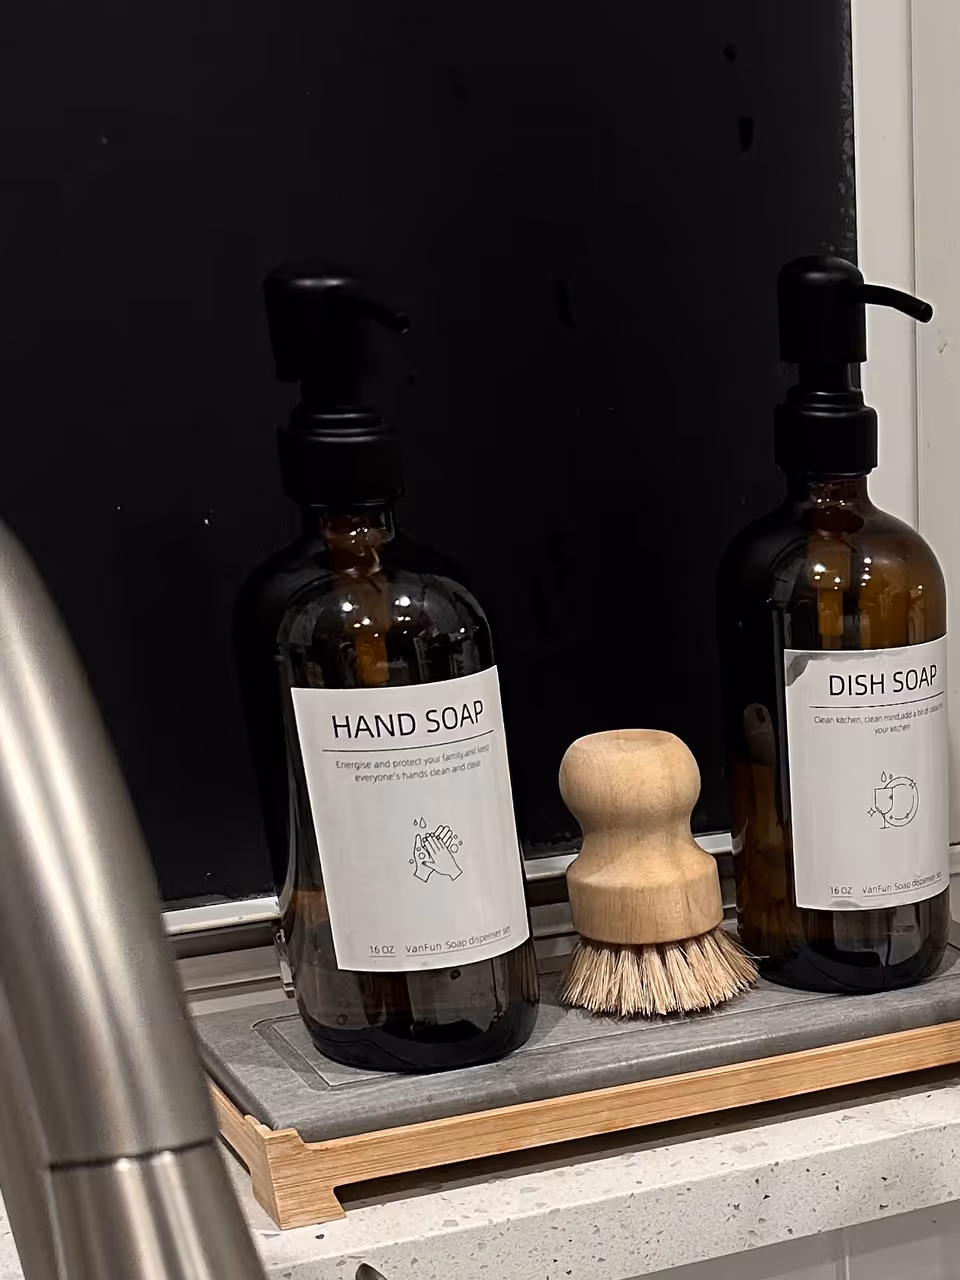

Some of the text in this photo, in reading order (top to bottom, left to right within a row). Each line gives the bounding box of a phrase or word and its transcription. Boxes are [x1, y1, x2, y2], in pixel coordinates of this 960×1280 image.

[828, 664, 938, 696] DISH SOAP
[331, 699, 484, 739] HAND SOAP
[814, 715, 834, 724] Clean
[864, 714, 883, 723] clean
[874, 726, 889, 736] your
[335, 760, 372, 771] Energise
[373, 760, 391, 769] and
[392, 758, 422, 770] protect
[423, 756, 441, 766] your
[354, 772, 401, 783] everyone's
[402, 769, 429, 780] hands
[429, 767, 451, 777] clean
[451, 762, 466, 773] and
[830, 886, 853, 895] 16 OZ
[862, 884, 892, 894] VanFun
[894, 881, 911, 891] Soap
[404, 943, 442, 953] VanFun
[445, 938, 467, 950] Soap
[468, 929, 502, 945] dispenser
[369, 945, 395, 954] 16 OZ
